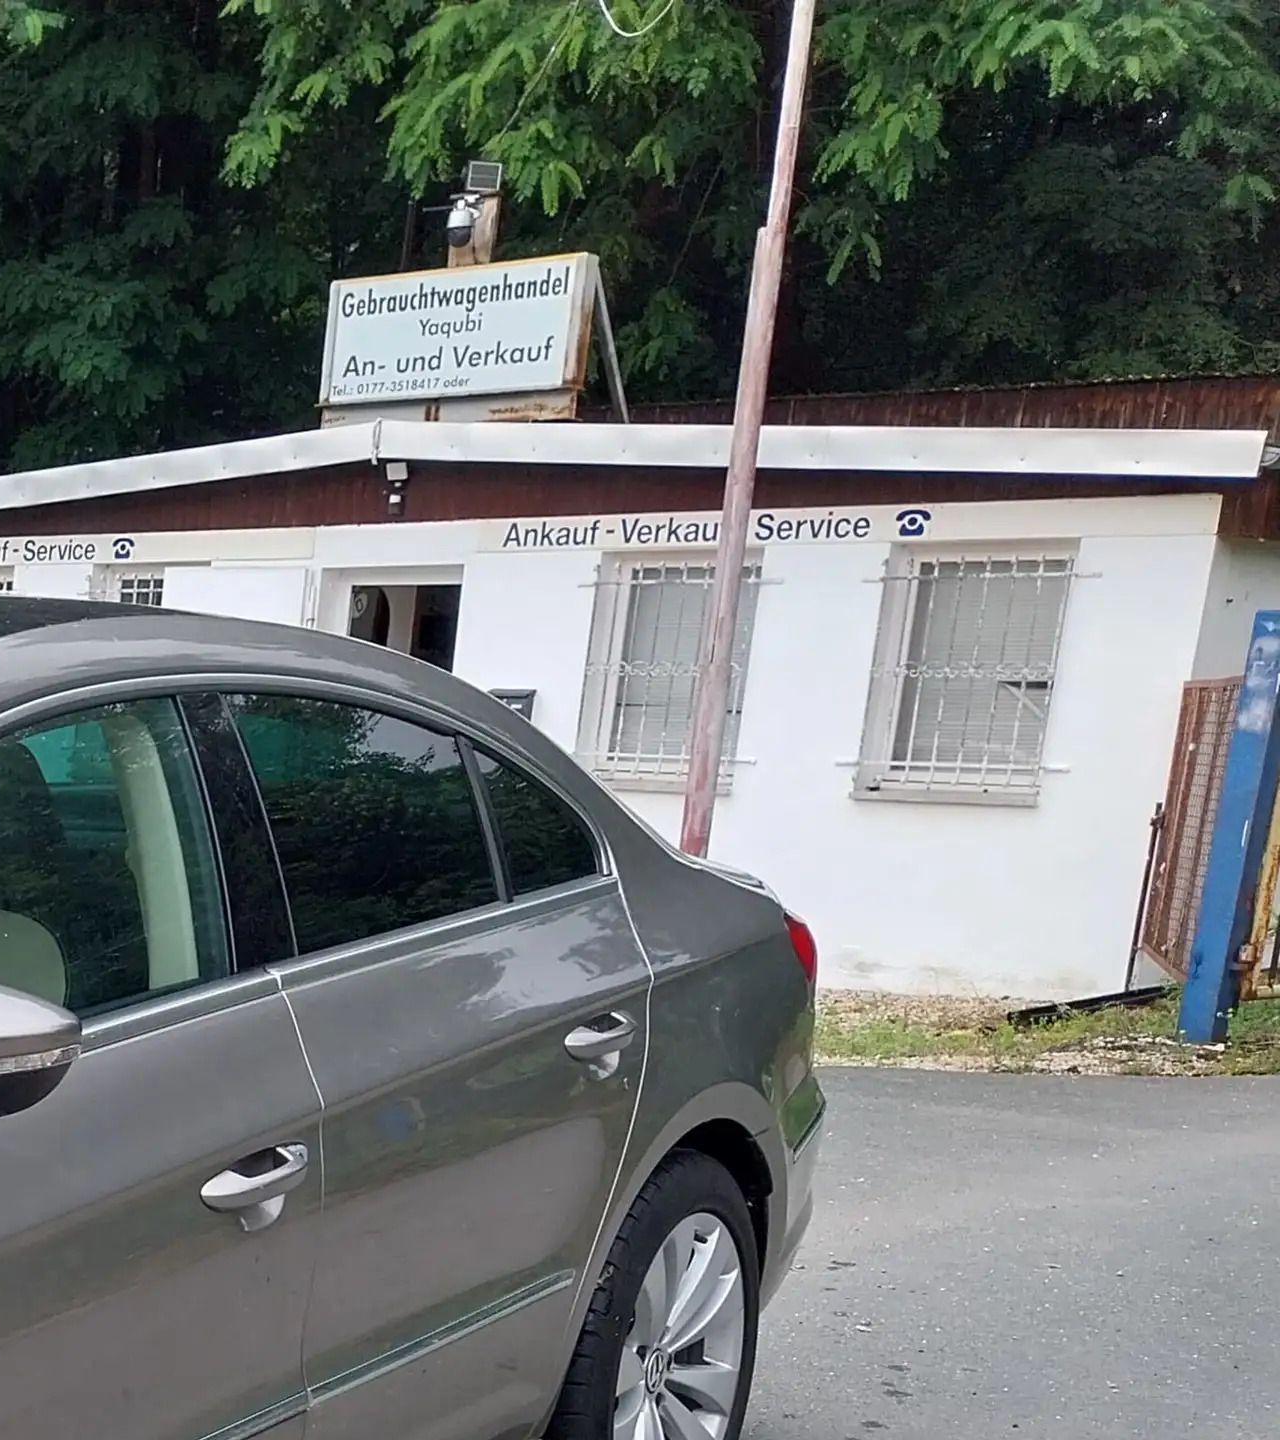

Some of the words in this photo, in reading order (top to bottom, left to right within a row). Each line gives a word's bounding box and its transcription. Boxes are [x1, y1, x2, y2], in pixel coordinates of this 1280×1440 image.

[341, 265, 571, 318] Gebrauchtwagenhandel
[419, 312, 483, 339] Yaqubi
[342, 355, 387, 378] An-
[396, 346, 441, 373] und
[452, 335, 555, 369] Verkauf
[443, 376, 470, 388] oder
[621, 516, 720, 544] Verkau
[754, 511, 871, 541] Service
